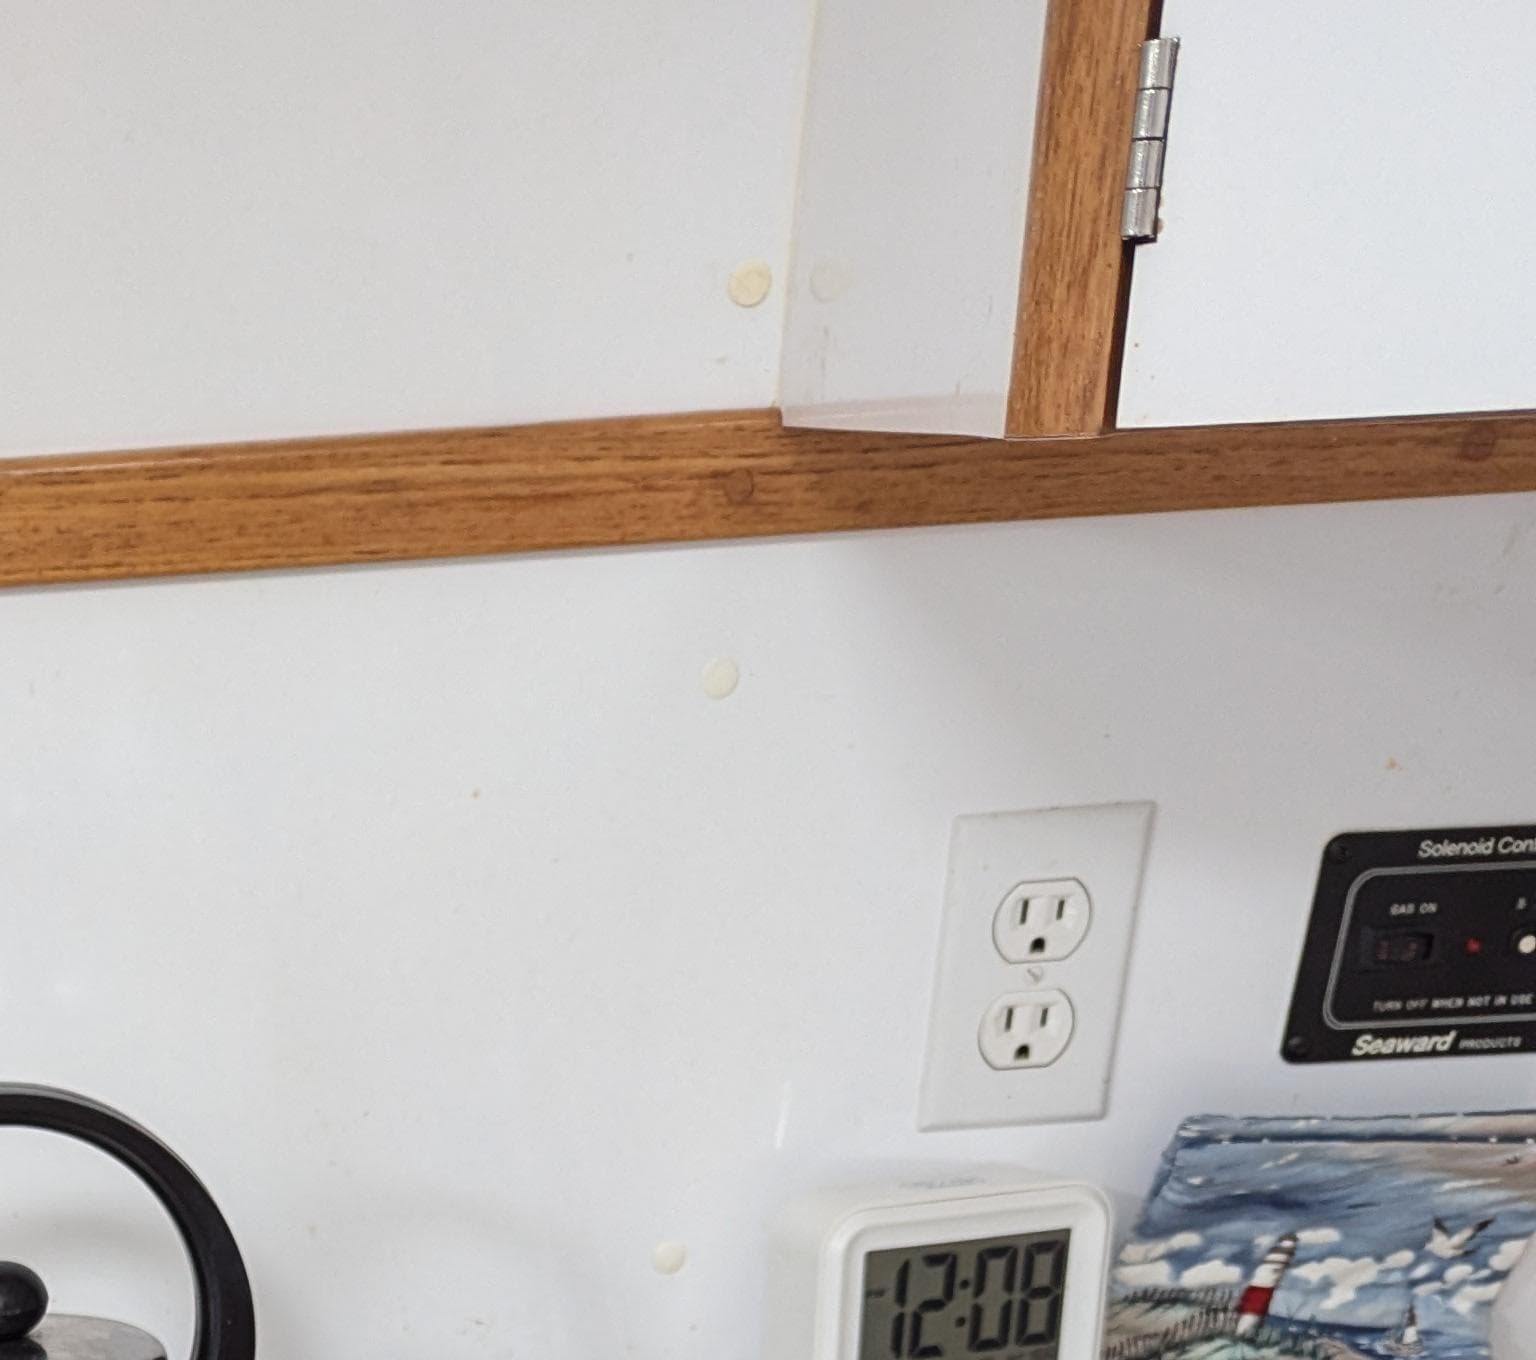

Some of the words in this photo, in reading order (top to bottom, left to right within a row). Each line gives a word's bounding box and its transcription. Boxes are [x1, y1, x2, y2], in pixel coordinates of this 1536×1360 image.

[1418, 837, 1496, 858] Solenoid
[1419, 902, 1438, 914] ON
[1467, 995, 1491, 1008] NOT
[1493, 994, 1507, 1006] IN
[1352, 1030, 1458, 1057] Seaward
[1459, 1036, 1522, 1050] PRODUCTS
[891, 1240, 1068, 1360] 12:08
